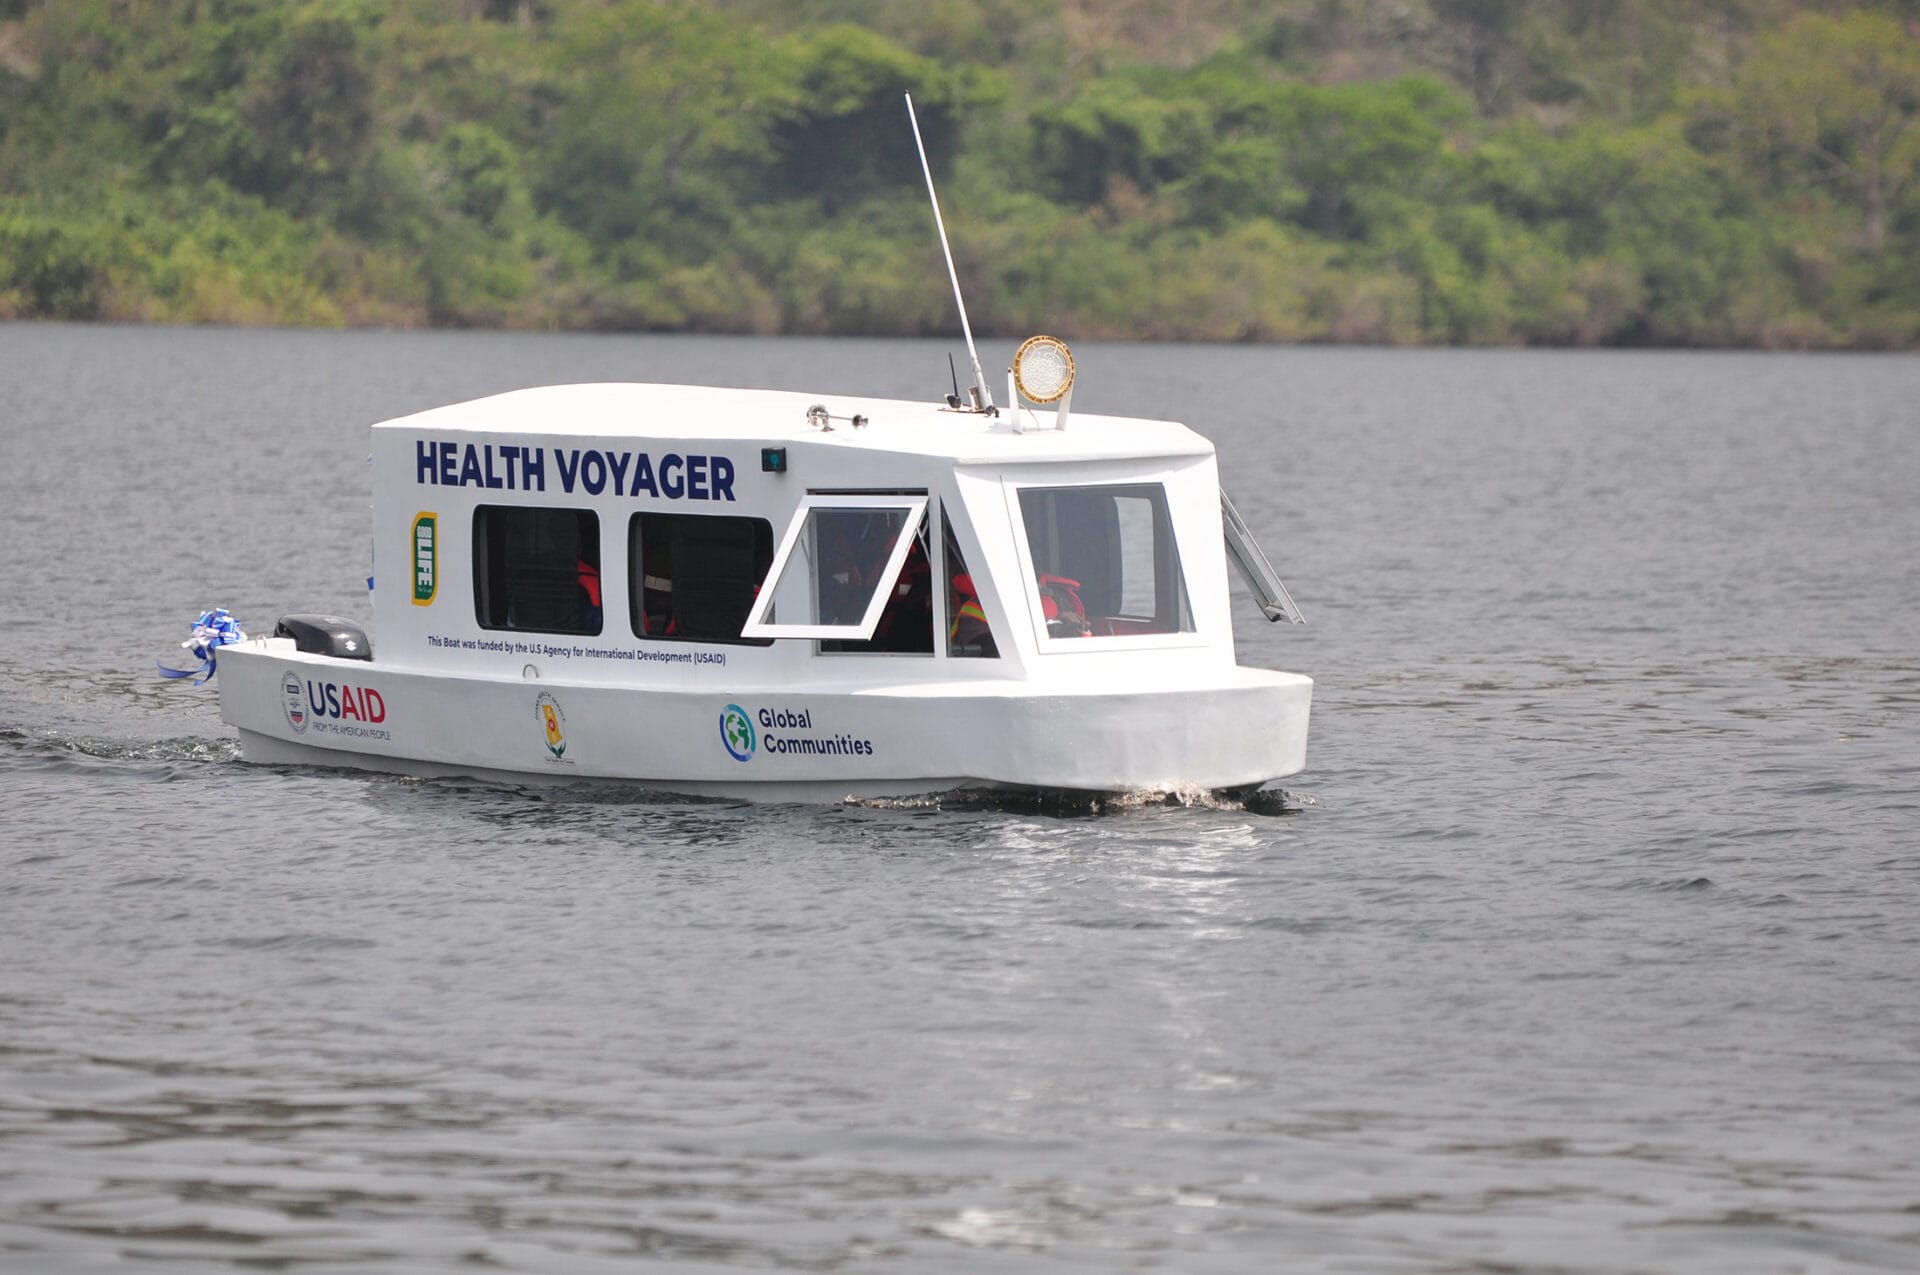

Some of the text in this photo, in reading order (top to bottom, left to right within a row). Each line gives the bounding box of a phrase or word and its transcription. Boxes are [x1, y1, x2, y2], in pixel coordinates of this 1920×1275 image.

[416, 440, 736, 501] HEALTH VOYAGER
[417, 539, 432, 586] LIFE
[428, 635, 442, 647] This
[443, 637, 460, 648] Boat
[461, 640, 476, 649] was
[477, 639, 503, 651] funded
[504, 641, 514, 654] by
[515, 642, 528, 653] the
[542, 645, 571, 657] Agency
[572, 646, 583, 656] for
[585, 647, 634, 660] International
[637, 650, 692, 663] Development
[693, 652, 726, 666] (USAID)
[307, 680, 385, 723] USAID
[312, 721, 391, 740] FROM THE AMERICAN PEOPLE
[758, 708, 812, 729] Global
[763, 733, 873, 755] Communities
